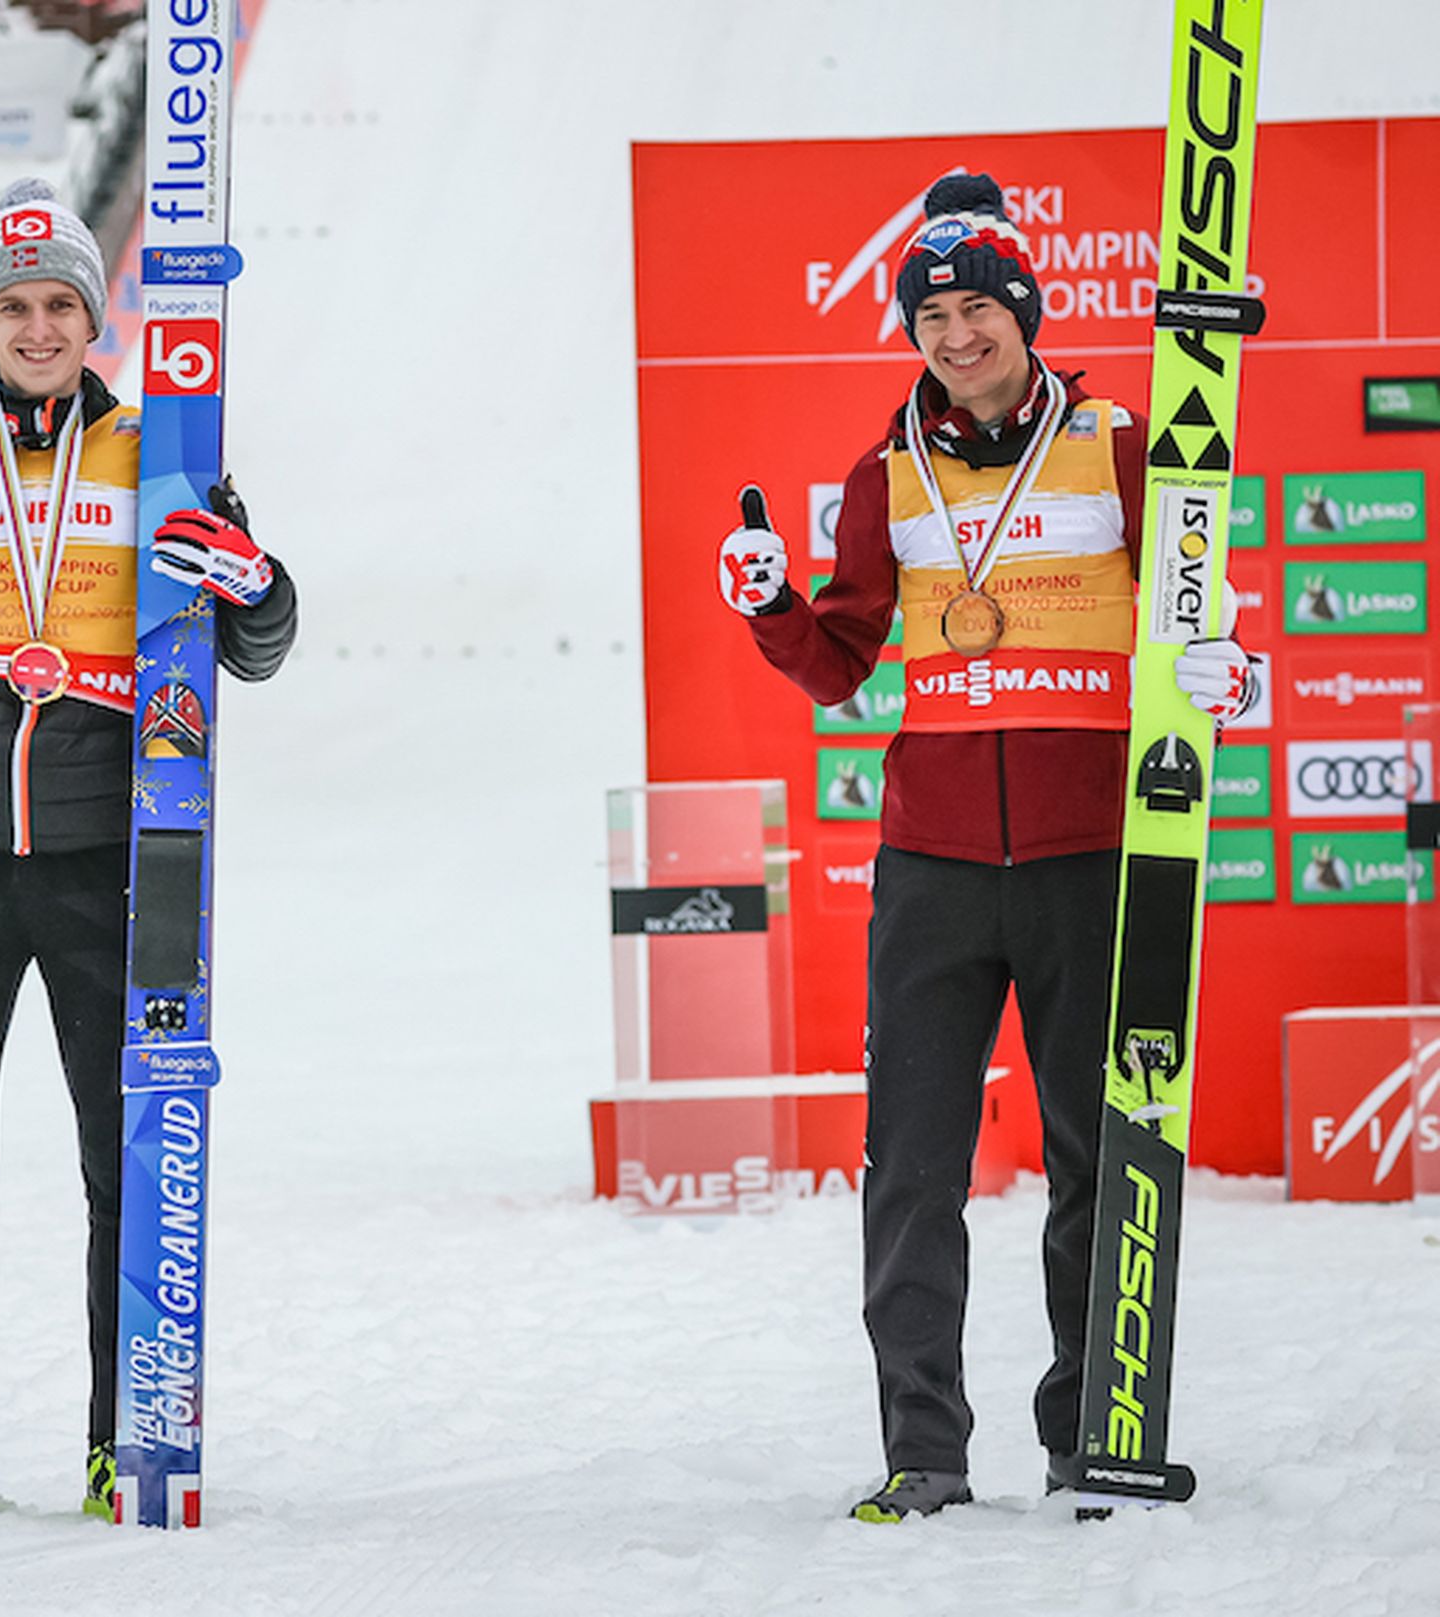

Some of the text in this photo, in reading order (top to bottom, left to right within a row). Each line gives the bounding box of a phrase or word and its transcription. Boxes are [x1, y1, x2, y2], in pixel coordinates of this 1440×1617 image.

[1003, 186, 1063, 225] SKI
[1032, 229, 1160, 273] UMPIN
[1042, 278, 1158, 321] ORLD
[957, 514, 1043, 545] STCH
[54, 579, 97, 595] CUP
[991, 573, 1082, 596] JUMPING
[913, 659, 1112, 707] VIESSMANN
[157, 1096, 202, 1316] GRANERUD
[1107, 1163, 1161, 1462] FISCHE
